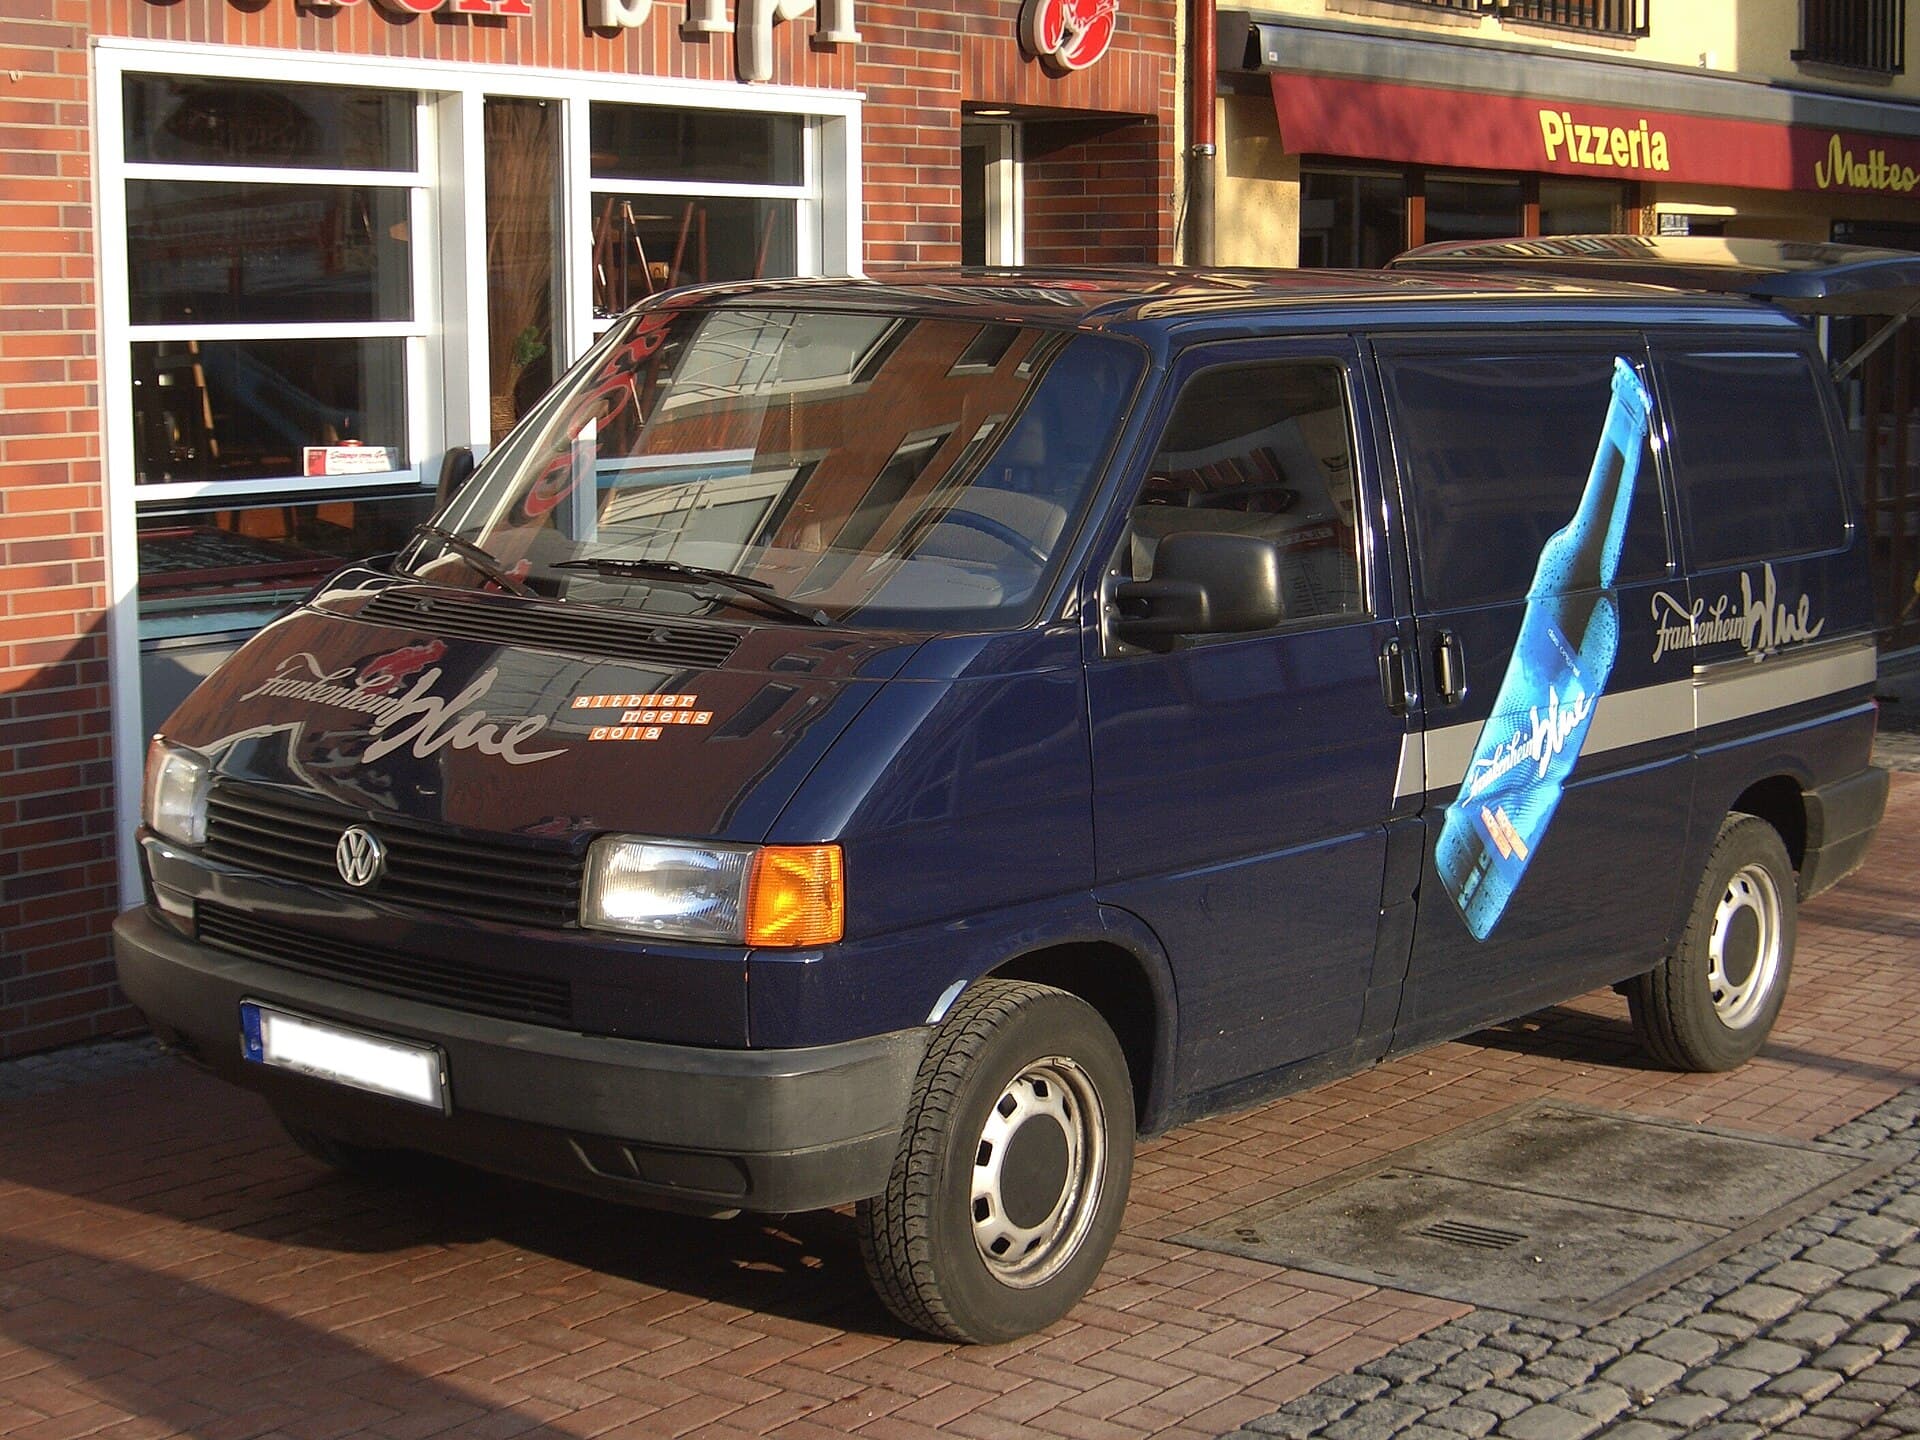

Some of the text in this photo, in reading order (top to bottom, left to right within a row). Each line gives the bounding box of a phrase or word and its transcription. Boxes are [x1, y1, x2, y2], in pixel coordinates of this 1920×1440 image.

[1539, 109, 1670, 171] Pizzeria
[573, 694, 697, 708] altbier
[620, 710, 713, 724] meets
[590, 726, 662, 740] cola
